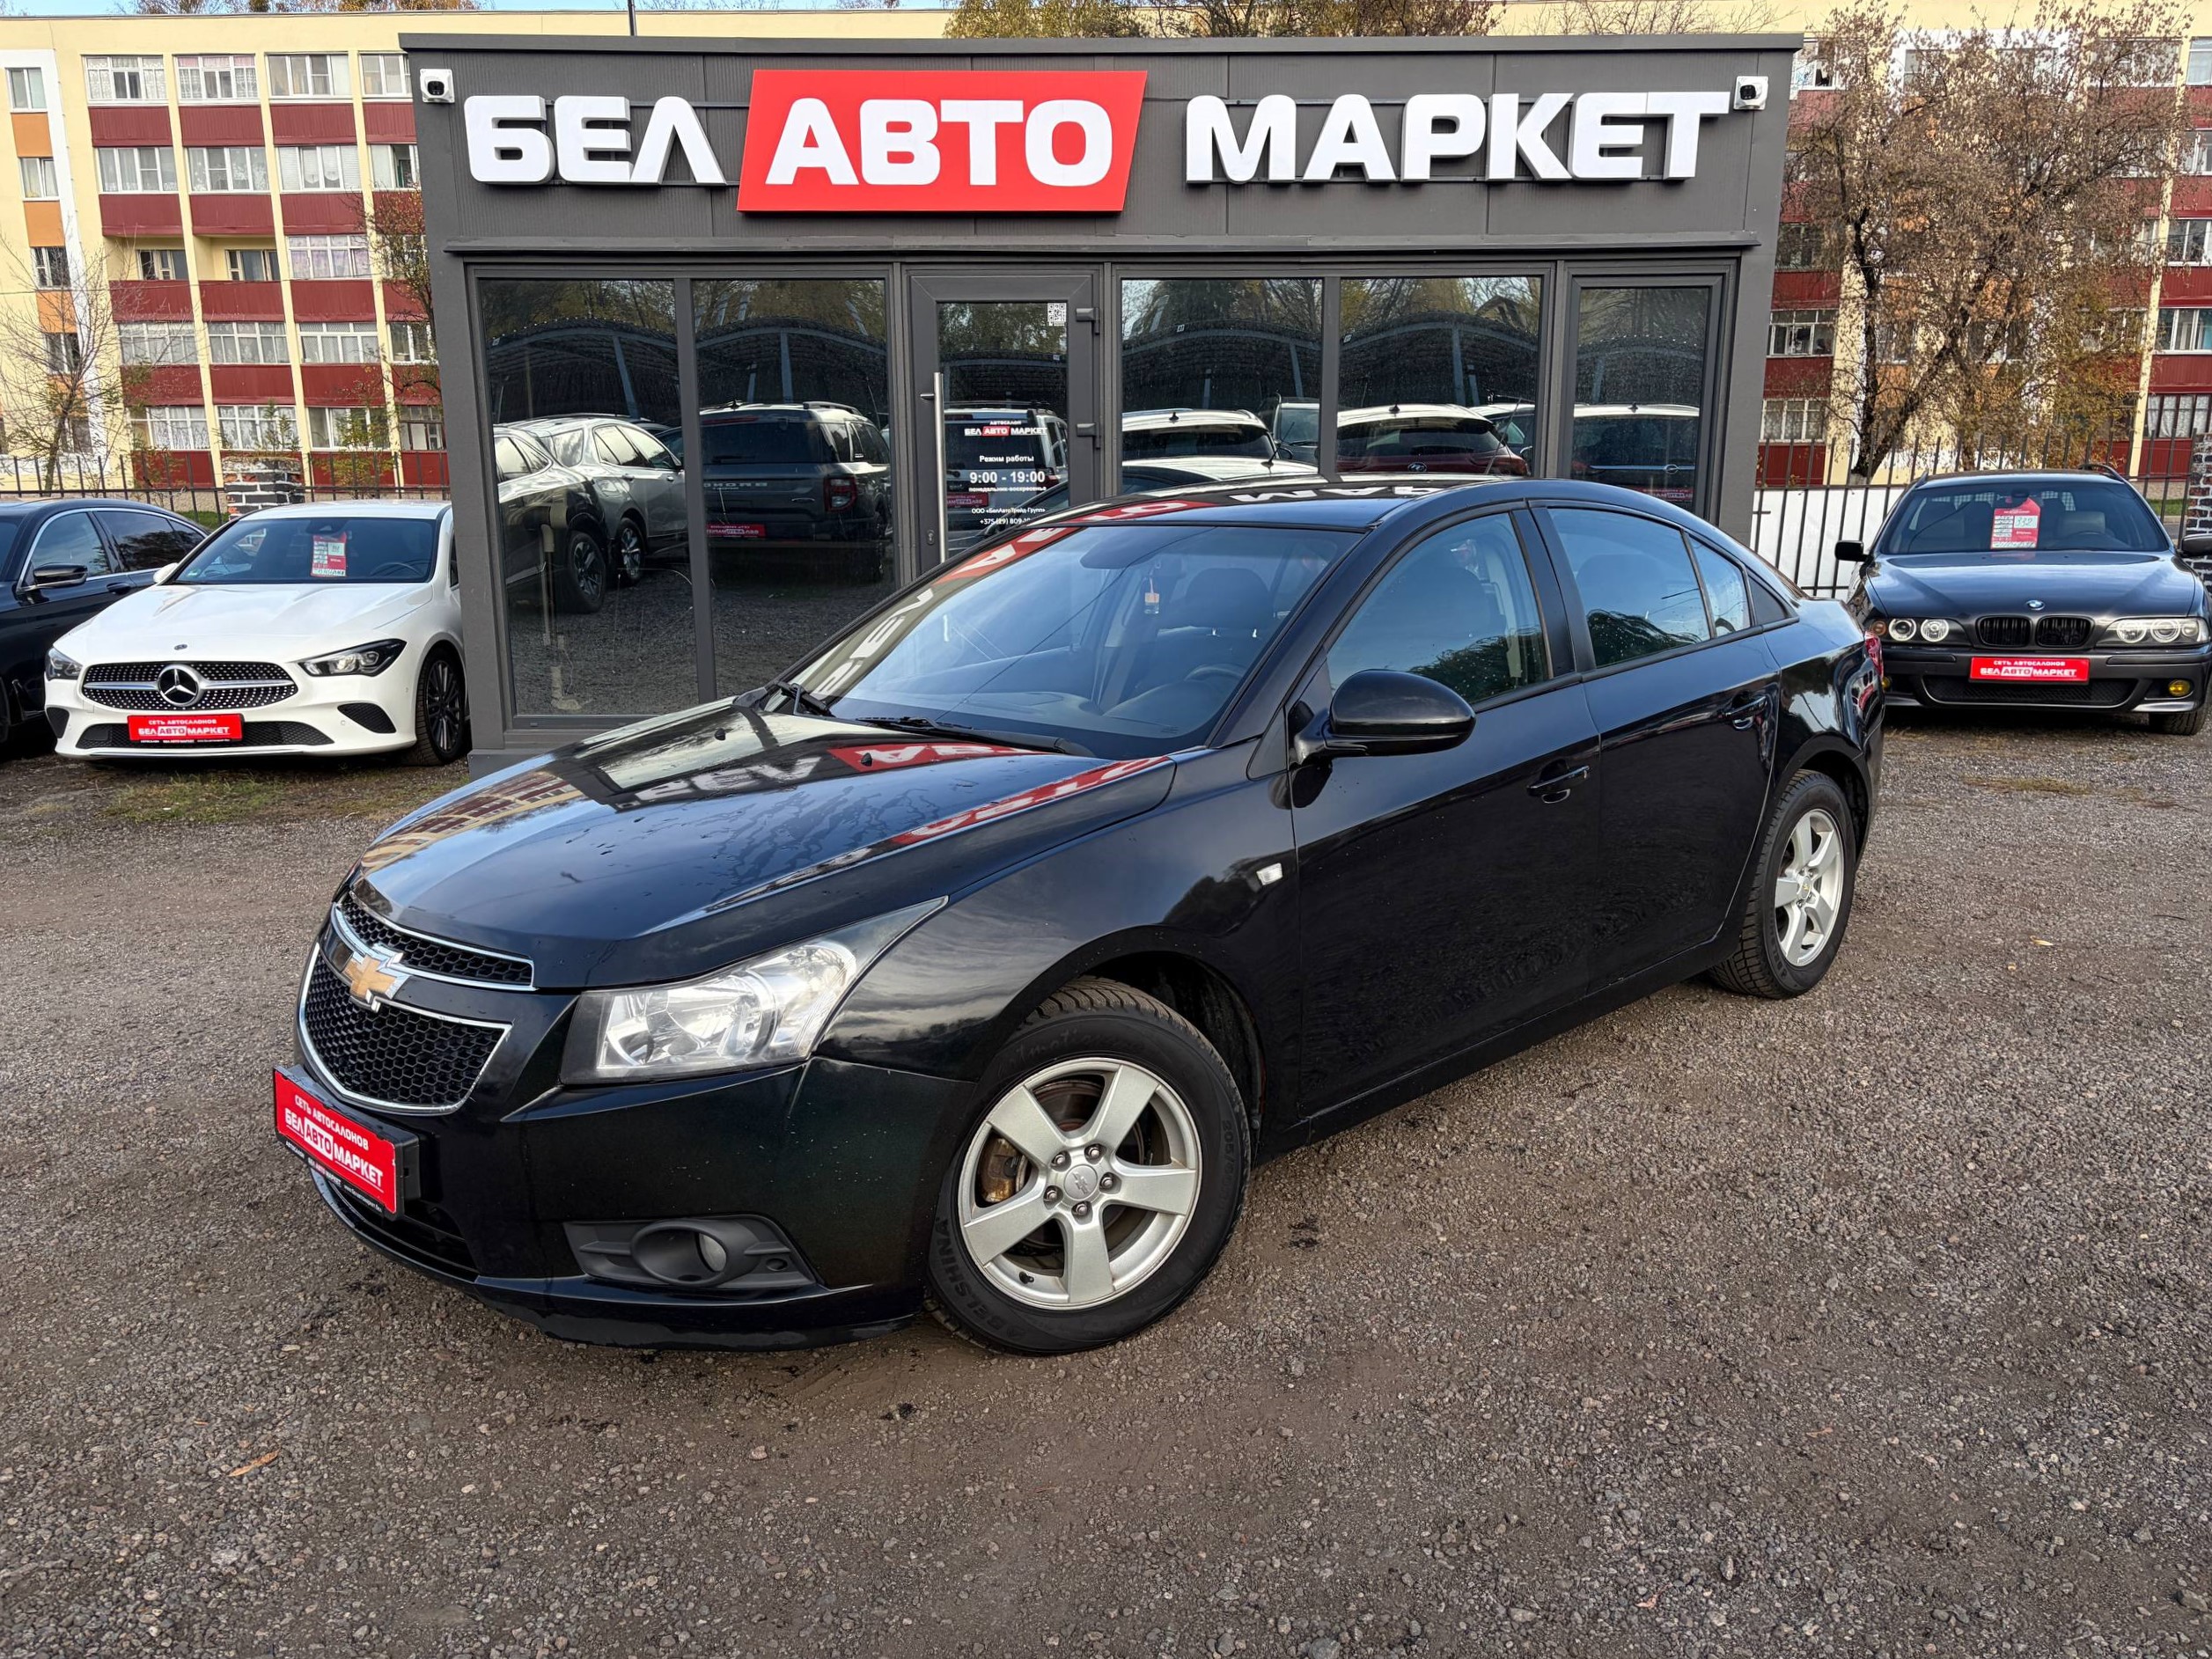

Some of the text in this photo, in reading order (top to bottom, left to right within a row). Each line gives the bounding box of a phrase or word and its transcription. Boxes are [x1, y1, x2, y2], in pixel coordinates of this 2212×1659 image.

[464, 91, 1730, 186] БЕЛ АВТО МАРКЕТ
[969, 472, 998, 484] 9:00
[1010, 471, 1046, 484] 19:00
[1980, 667, 2001, 676] БЕЛ
[284, 1107, 384, 1188] БЕЛ АВТО МАРКЕТ
[294, 1095, 369, 1151] СЕТЬ АВТОСАЛОНОВ
[936, 1220, 1006, 1331] BELSHINA
